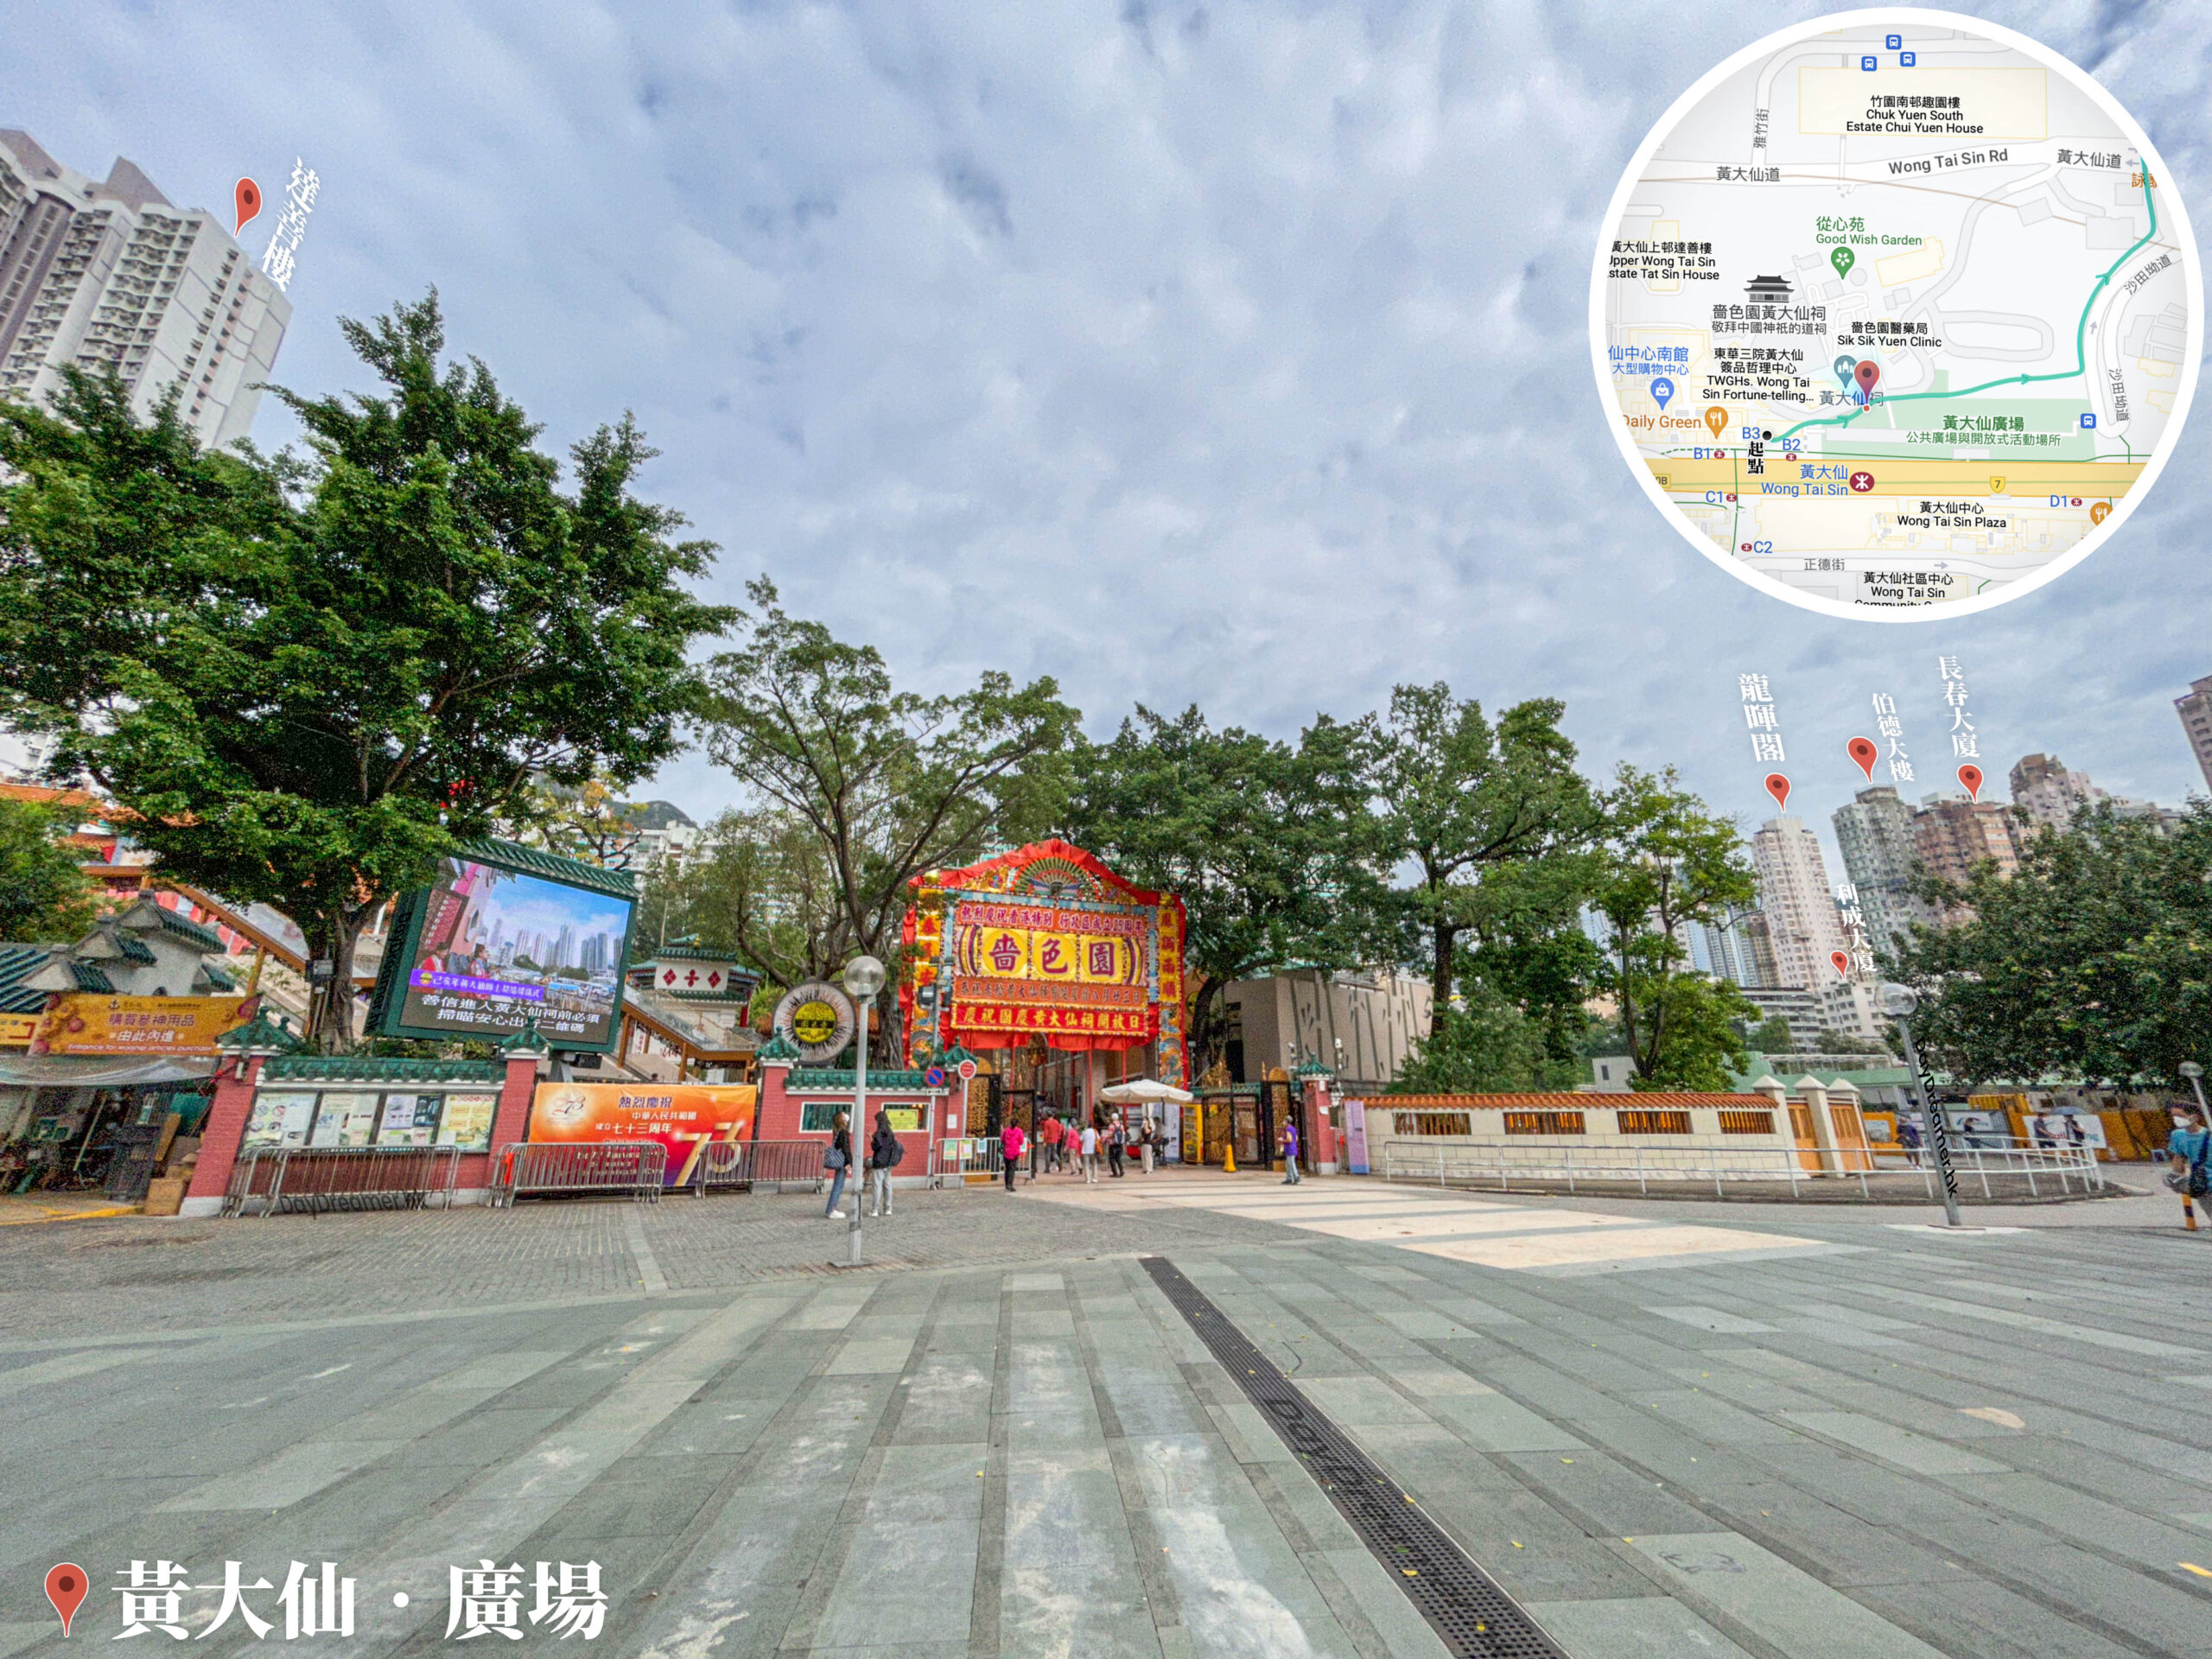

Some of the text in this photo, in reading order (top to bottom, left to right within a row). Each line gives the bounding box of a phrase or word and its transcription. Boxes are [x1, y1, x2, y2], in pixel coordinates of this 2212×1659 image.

[988, 932, 1116, 977] 嗇色園
[422, 993, 601, 1025] 善信進入黃大仙祠前必須
[963, 1006, 1141, 1029] 慶祝國慶黃大仙祠開放日
[618, 1096, 673, 1109] 熱烈慶祝
[631, 1111, 697, 1121] 中華人民共和國
